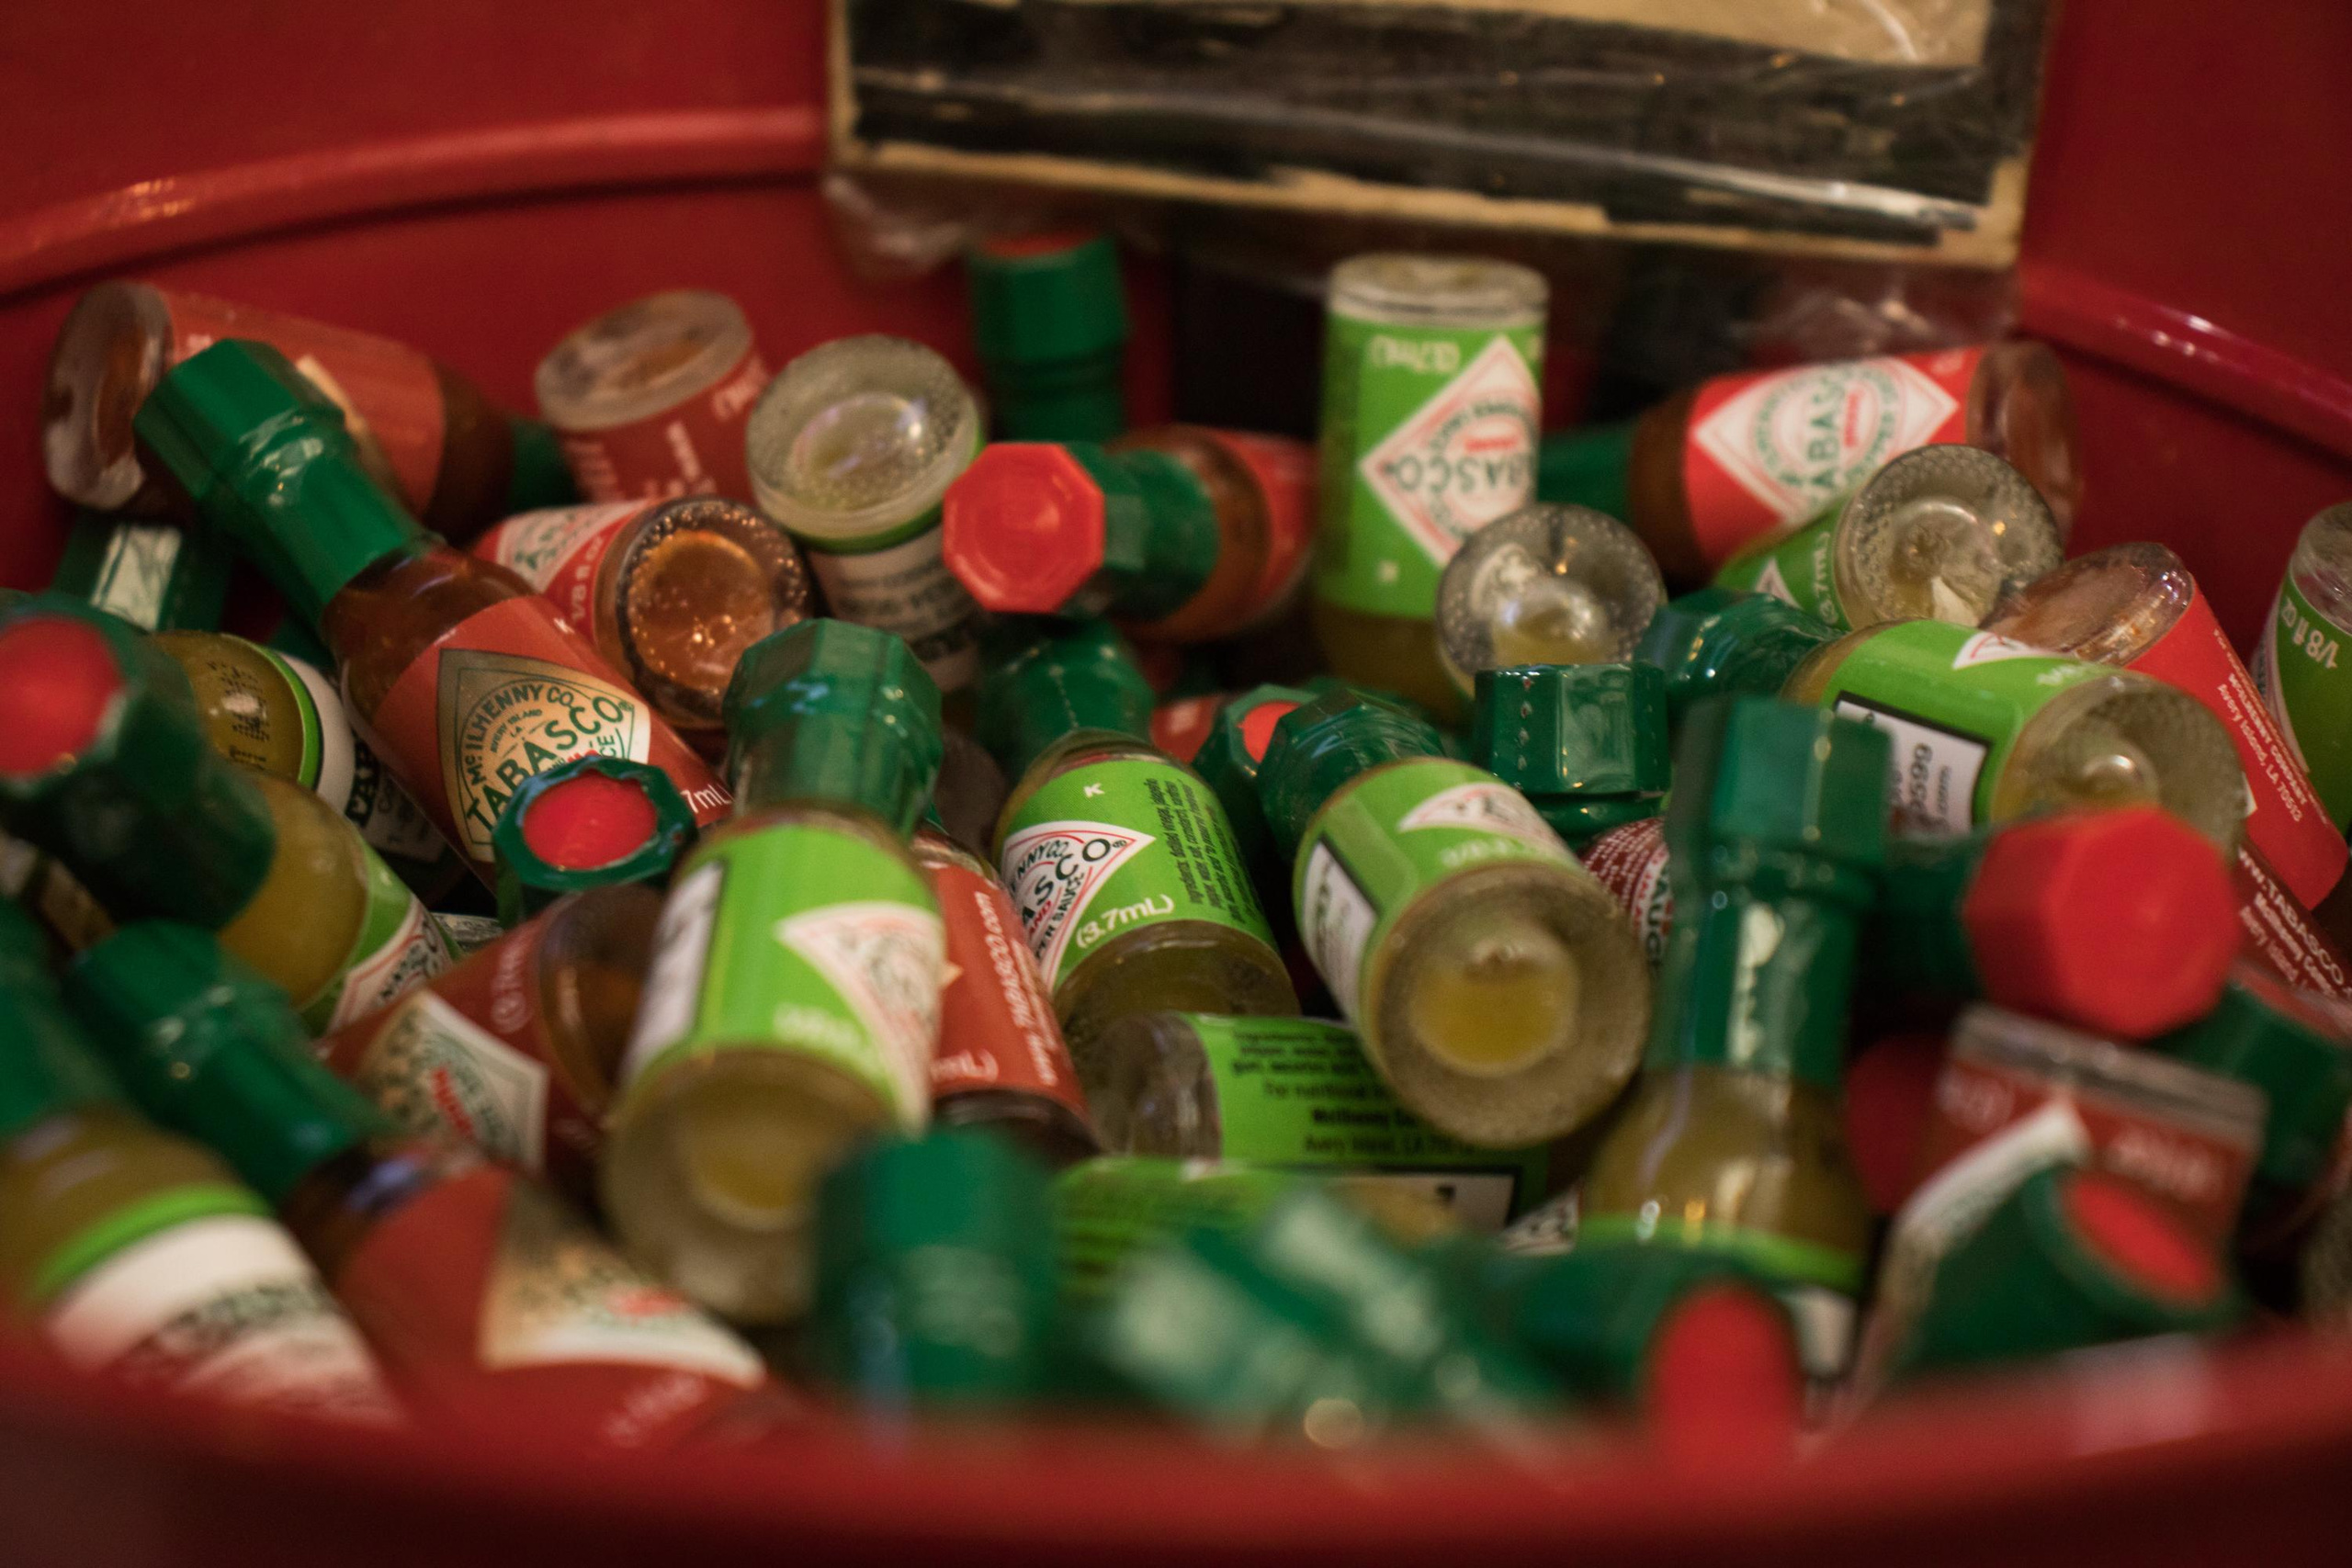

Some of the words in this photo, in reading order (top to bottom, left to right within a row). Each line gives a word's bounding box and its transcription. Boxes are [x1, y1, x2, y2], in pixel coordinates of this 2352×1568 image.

[466, 695, 625, 832] TABASCO
[1083, 783, 1105, 797] K
[1022, 838, 1112, 926] ASCO
[1029, 899, 1052, 937] AND
[1076, 894, 1174, 949] (3.7mL)
